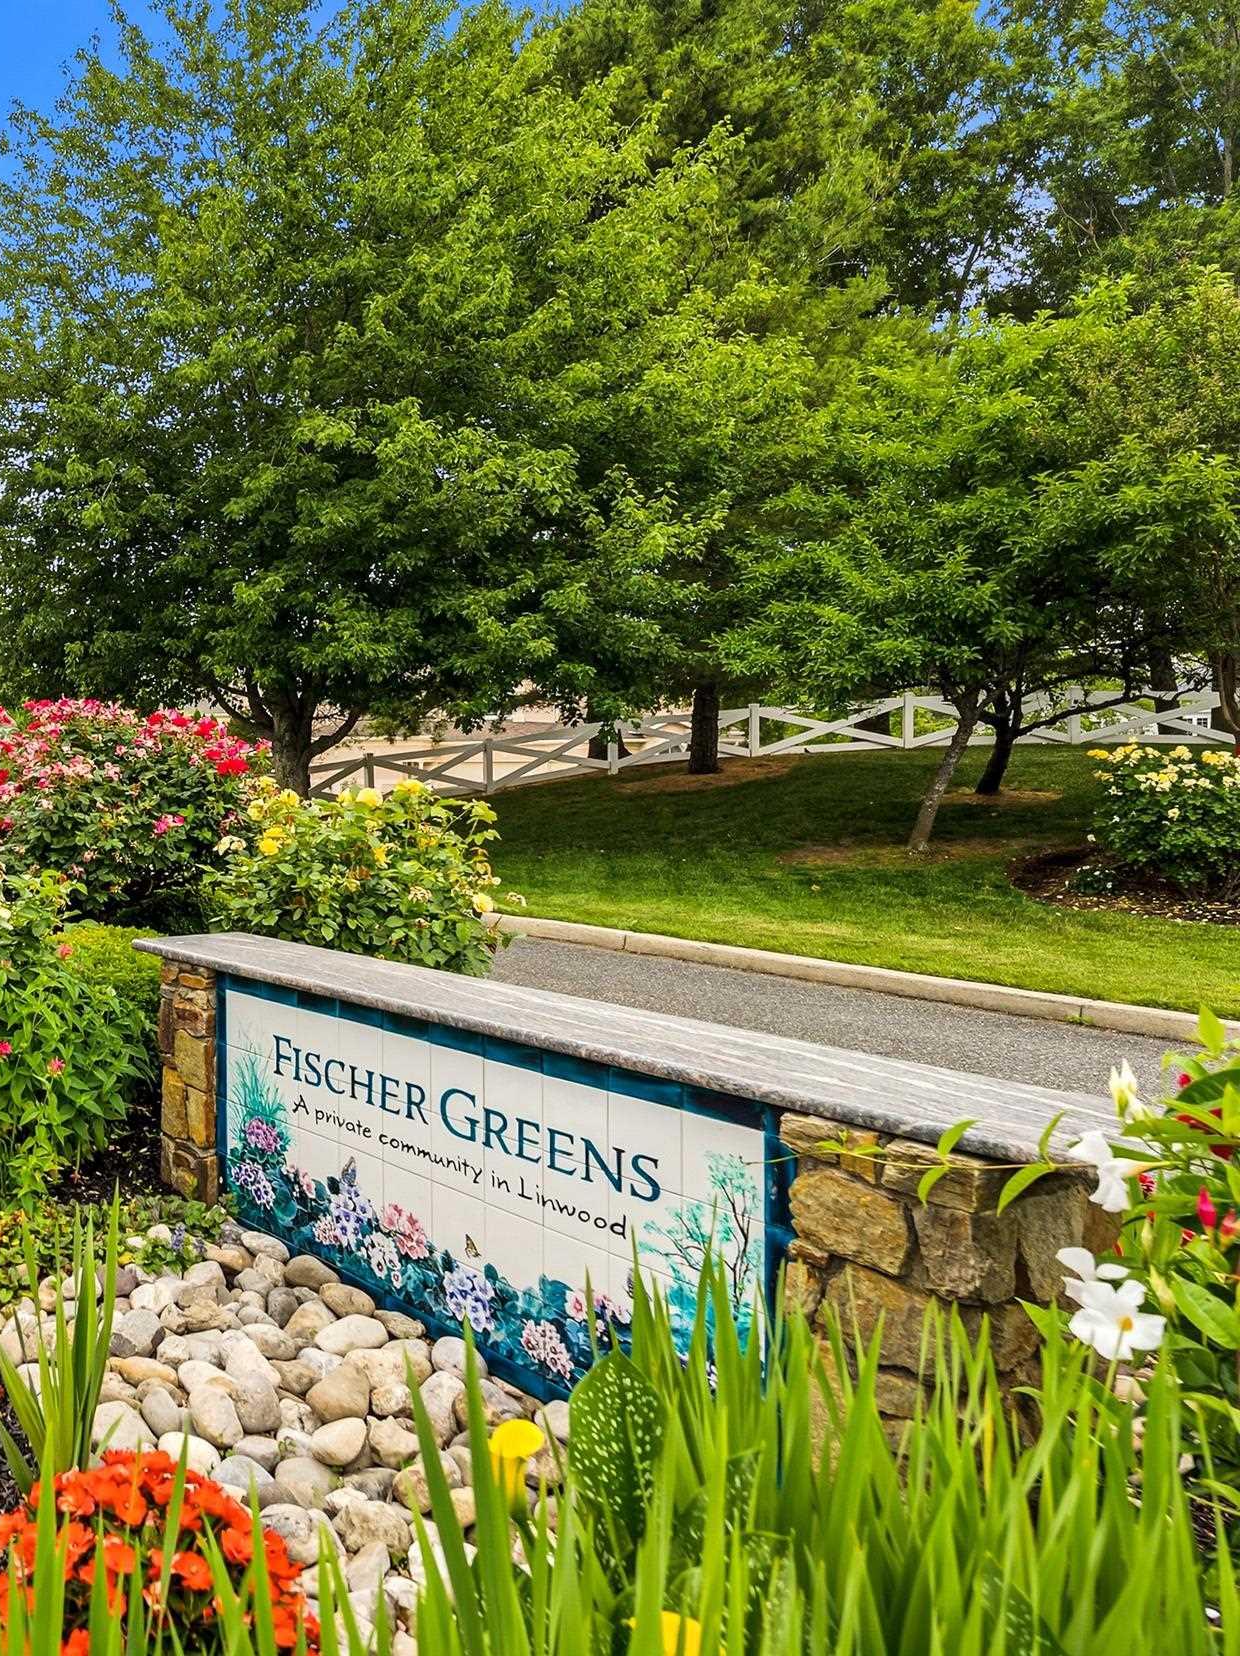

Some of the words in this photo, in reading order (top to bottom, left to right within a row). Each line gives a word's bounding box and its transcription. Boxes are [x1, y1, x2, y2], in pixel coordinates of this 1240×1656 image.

[272, 1034, 429, 1125] FISCHER
[440, 1087, 662, 1203] GREENS
[292, 1094, 310, 1116] A
[315, 1108, 373, 1139] private
[378, 1132, 483, 1184] community
[491, 1170, 511, 1193] in
[517, 1175, 627, 1240] Linwood
